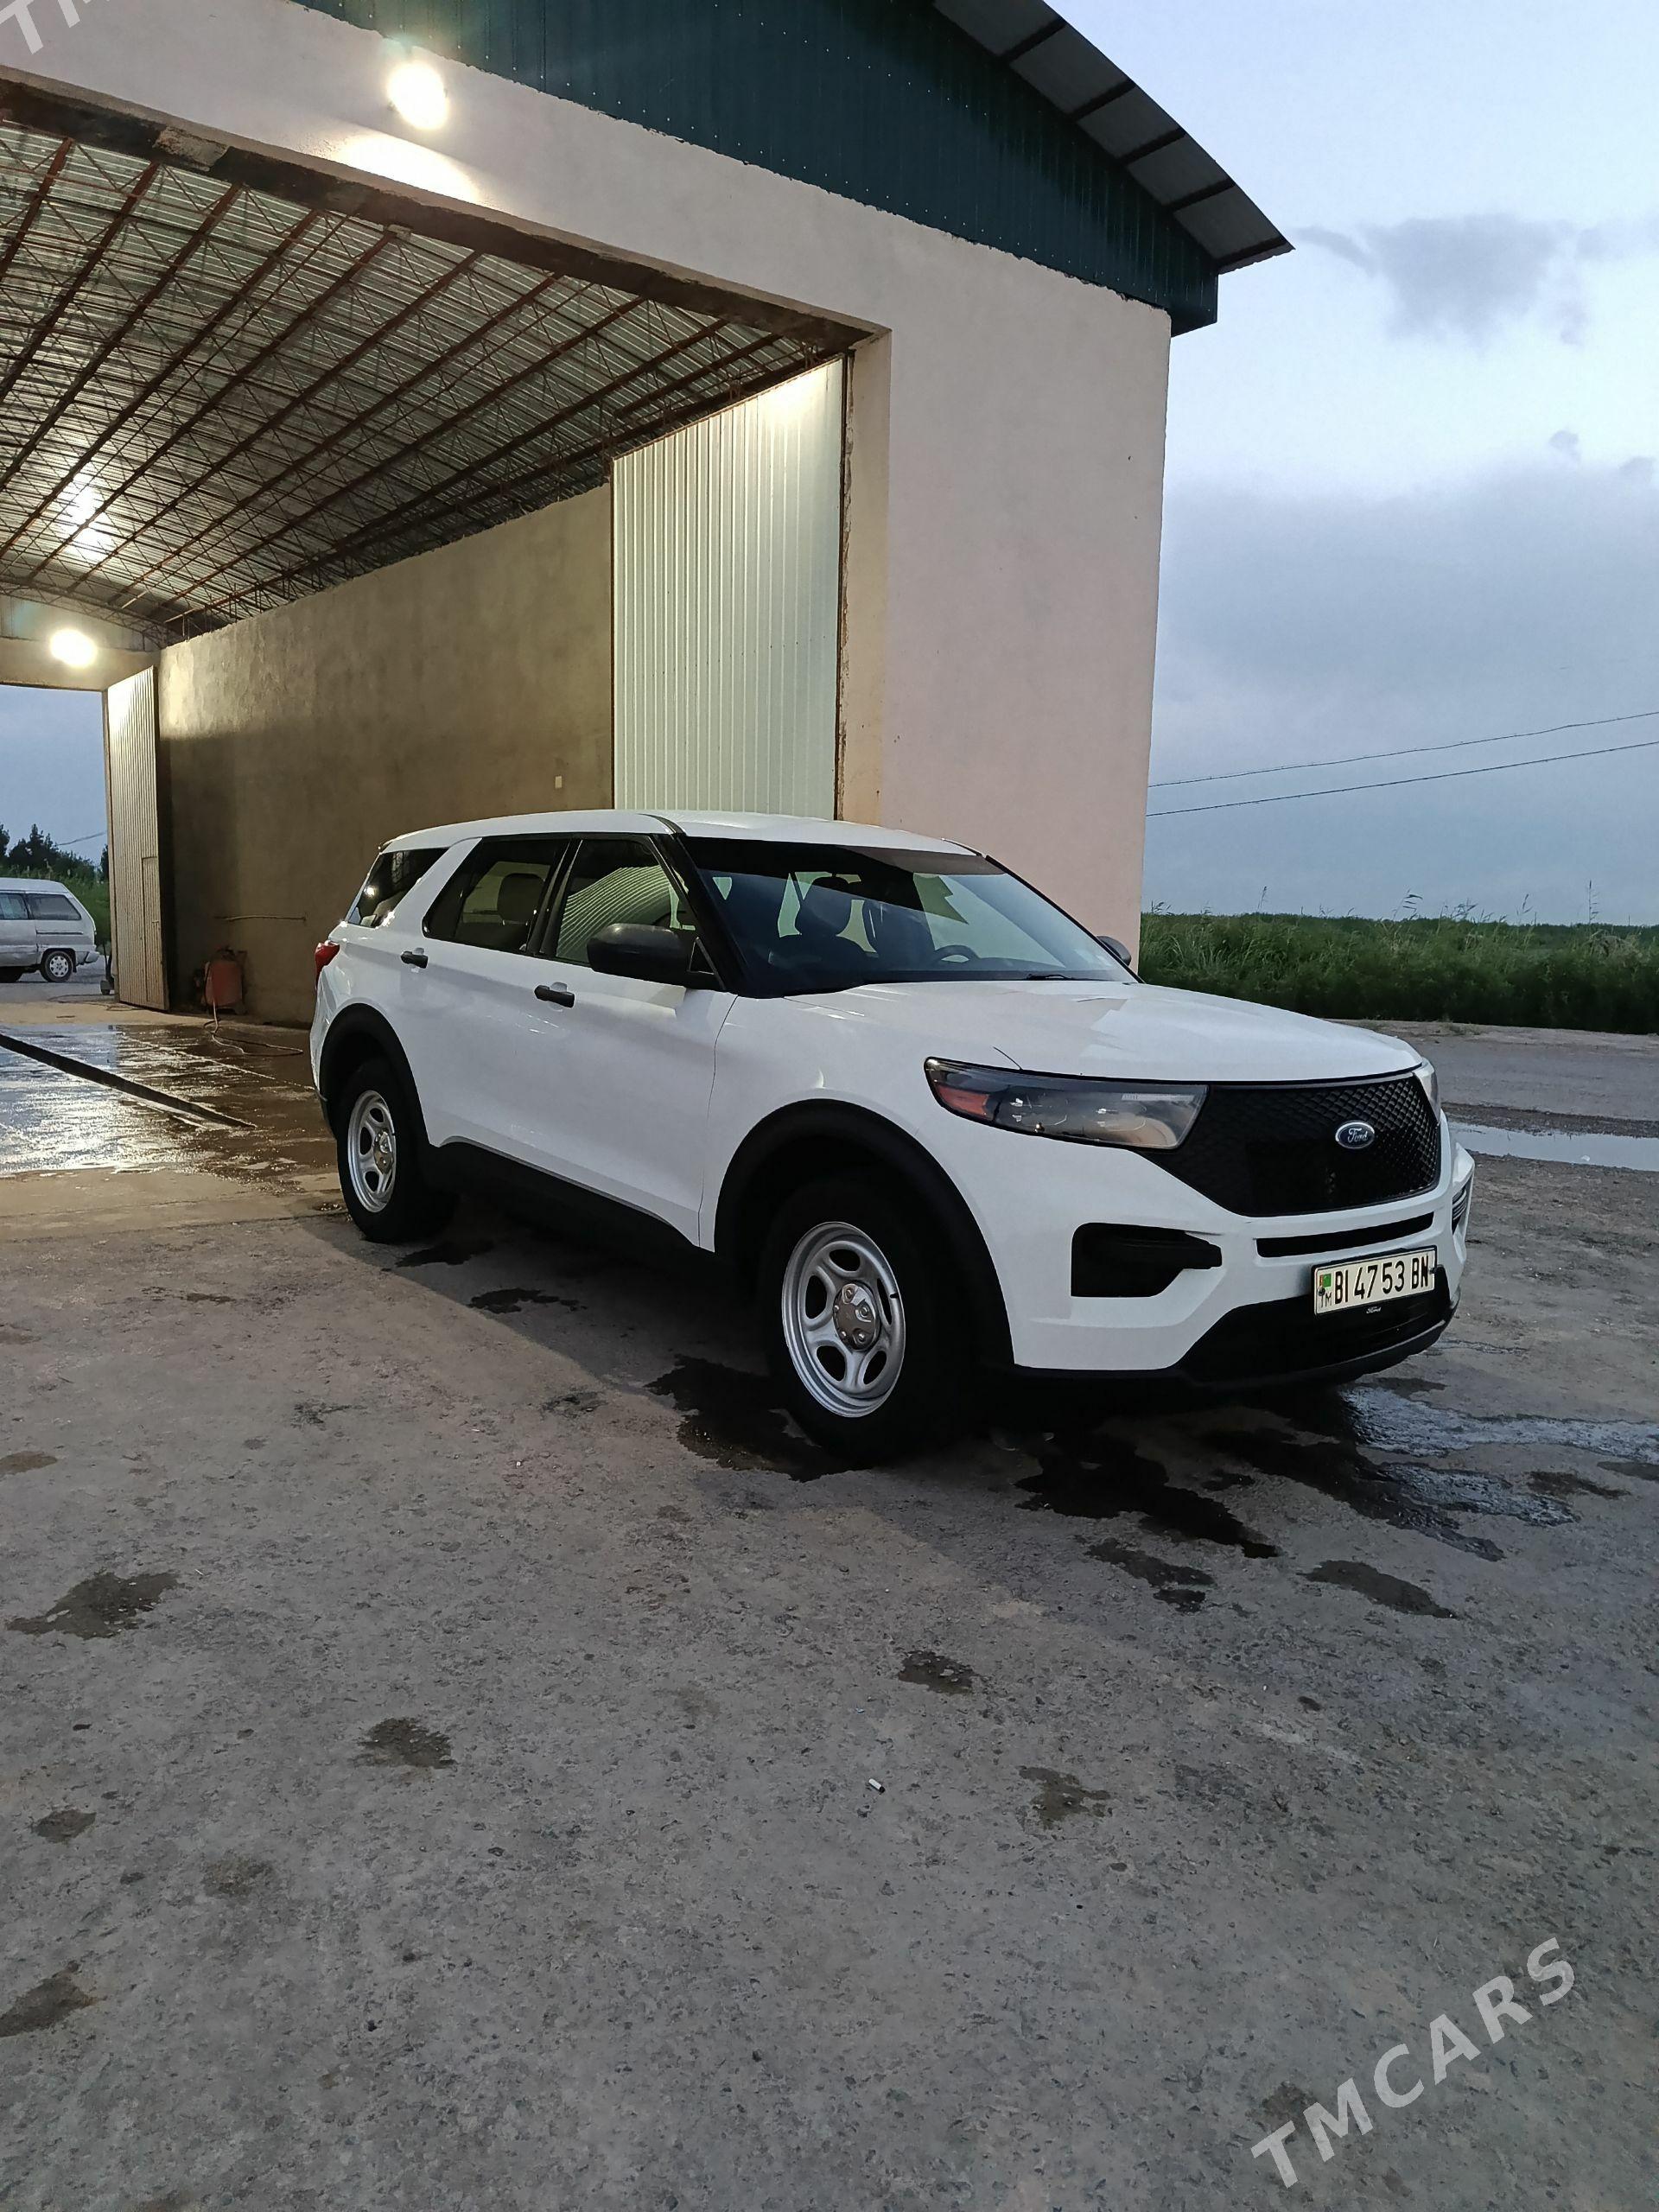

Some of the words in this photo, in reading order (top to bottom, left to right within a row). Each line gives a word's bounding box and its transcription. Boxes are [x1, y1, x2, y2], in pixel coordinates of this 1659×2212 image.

[1348, 1128, 1368, 1143] Ford
[1335, 1269, 1348, 1304] BI
[1354, 1261, 1404, 1299] 4753
[1412, 1255, 1428, 1288] BN
